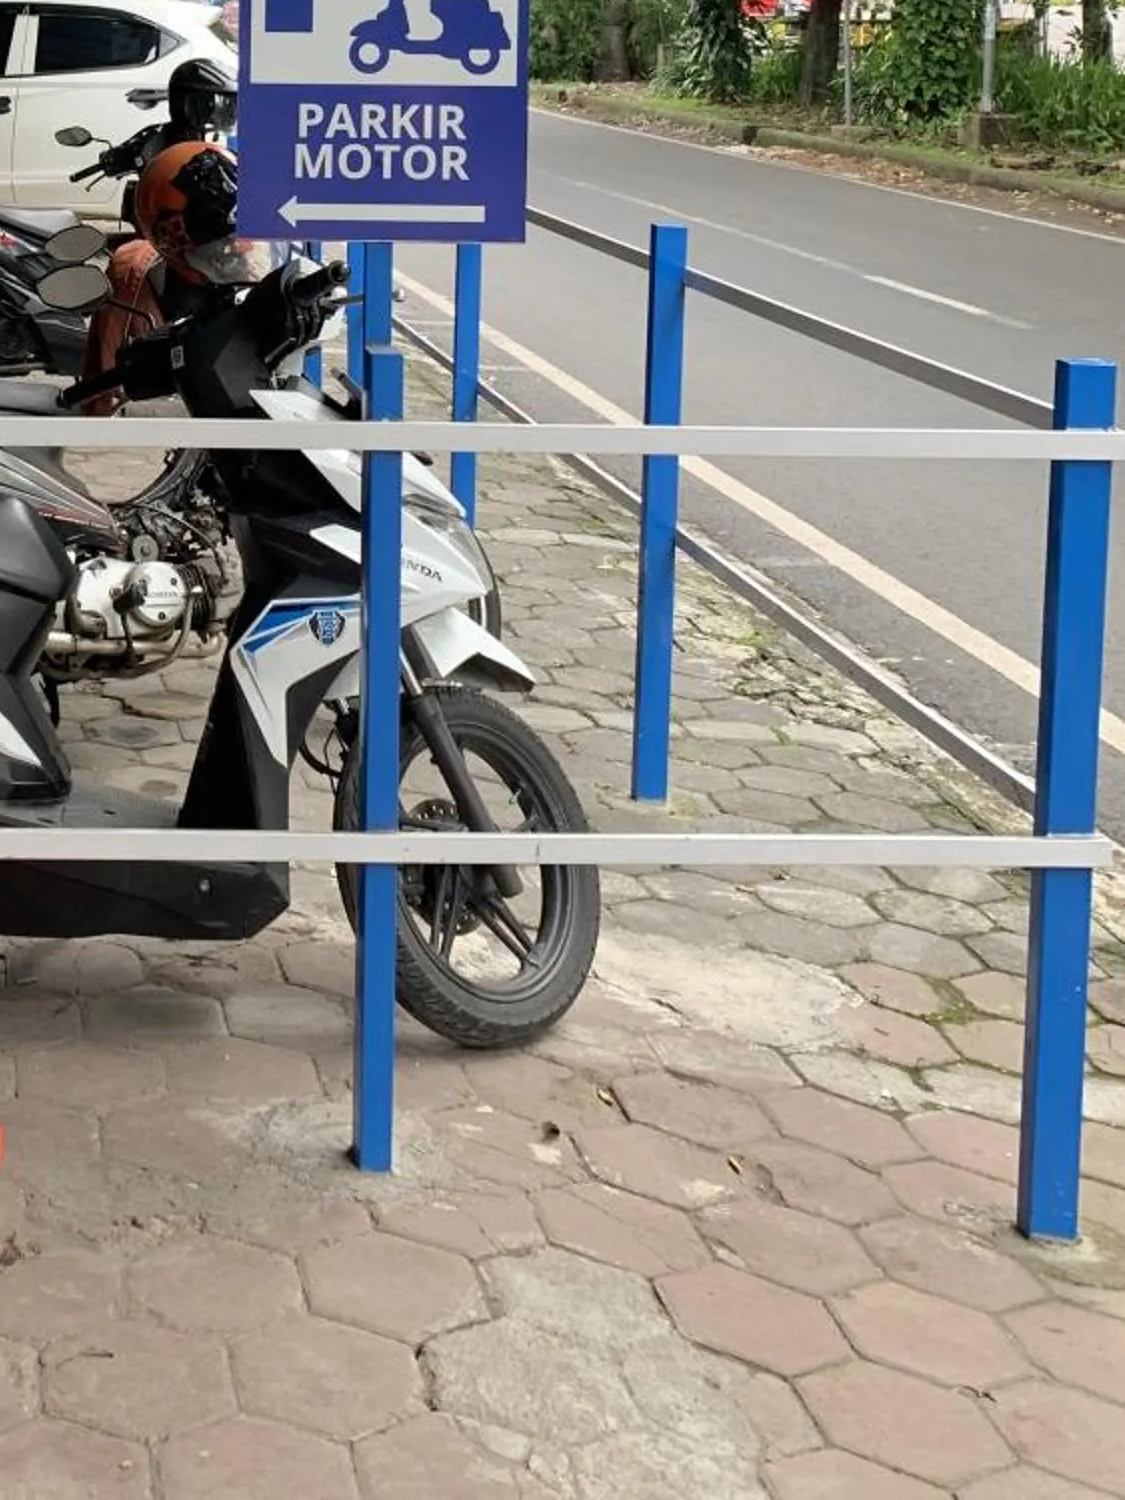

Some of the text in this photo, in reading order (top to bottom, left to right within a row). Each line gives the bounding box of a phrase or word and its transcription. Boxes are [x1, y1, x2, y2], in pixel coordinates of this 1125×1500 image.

[298, 102, 467, 141] PARKIR
[294, 143, 470, 181] MOTOR
[402, 558, 443, 583] NDA
